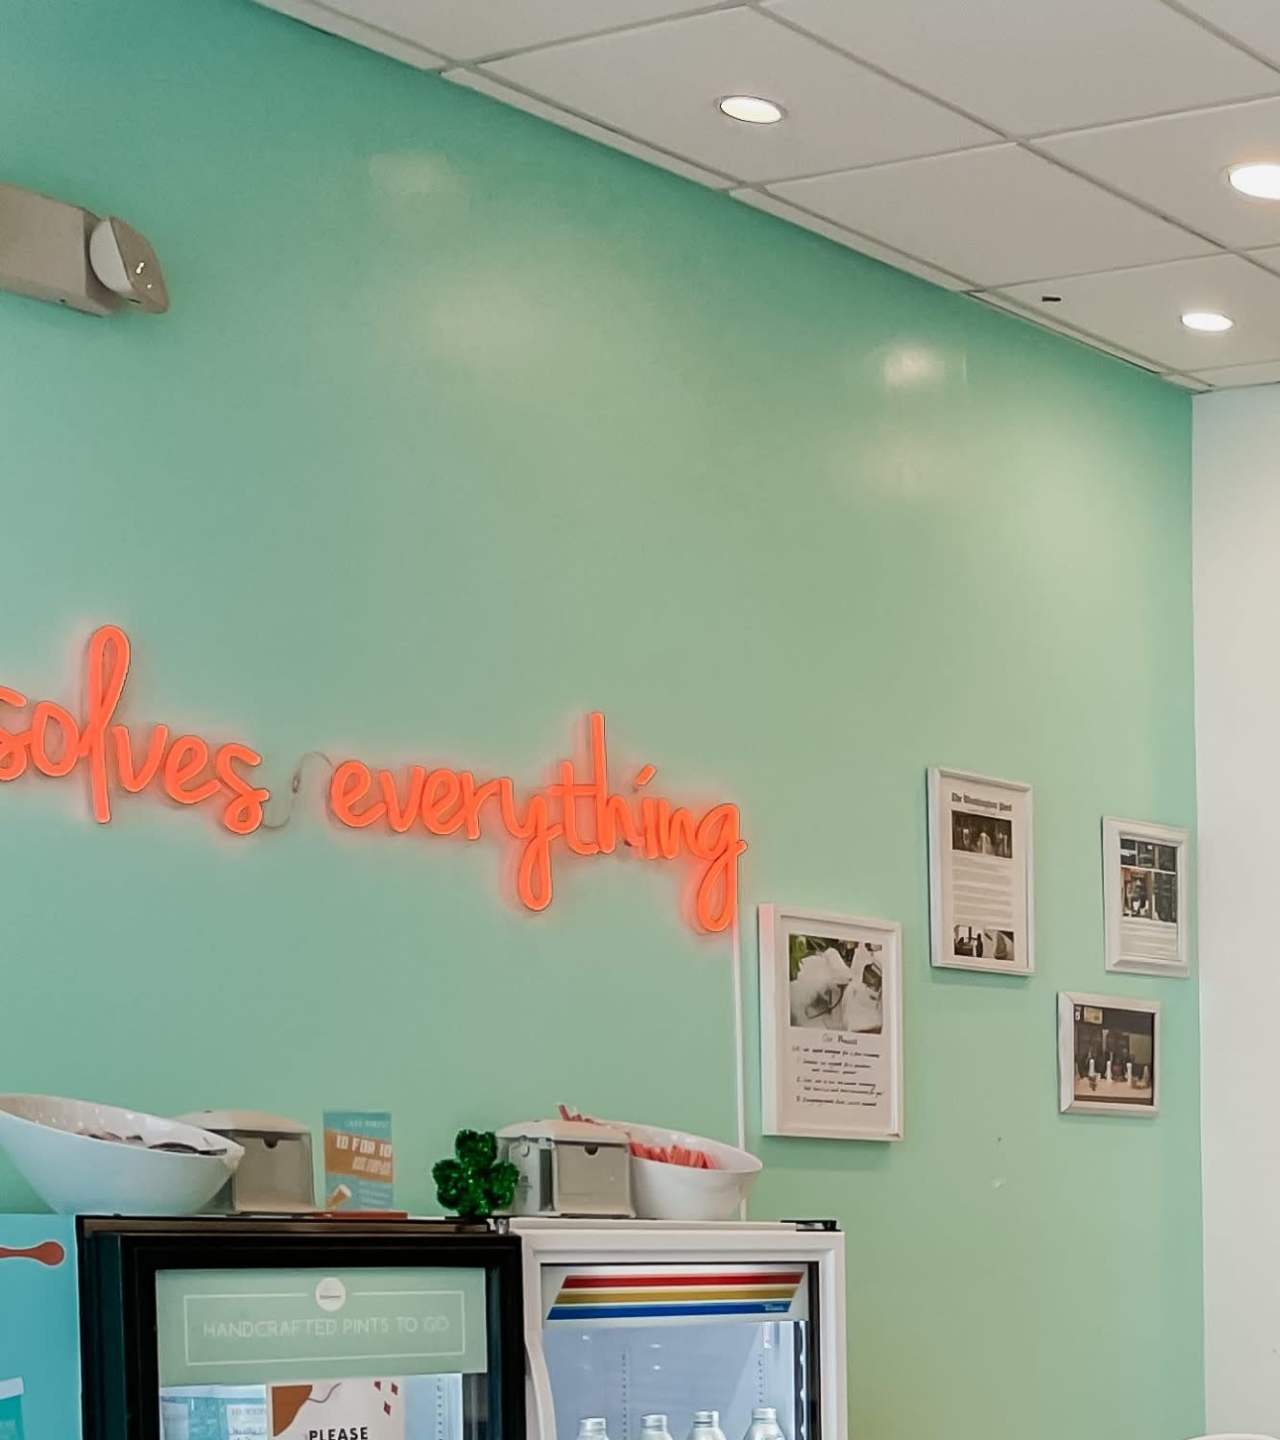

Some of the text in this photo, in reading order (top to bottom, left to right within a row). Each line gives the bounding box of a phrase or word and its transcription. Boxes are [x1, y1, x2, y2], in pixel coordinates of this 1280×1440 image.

[0, 625, 747, 933] solves everything
[203, 1315, 450, 1337] HANDCRAFTED PINTS TO GO
